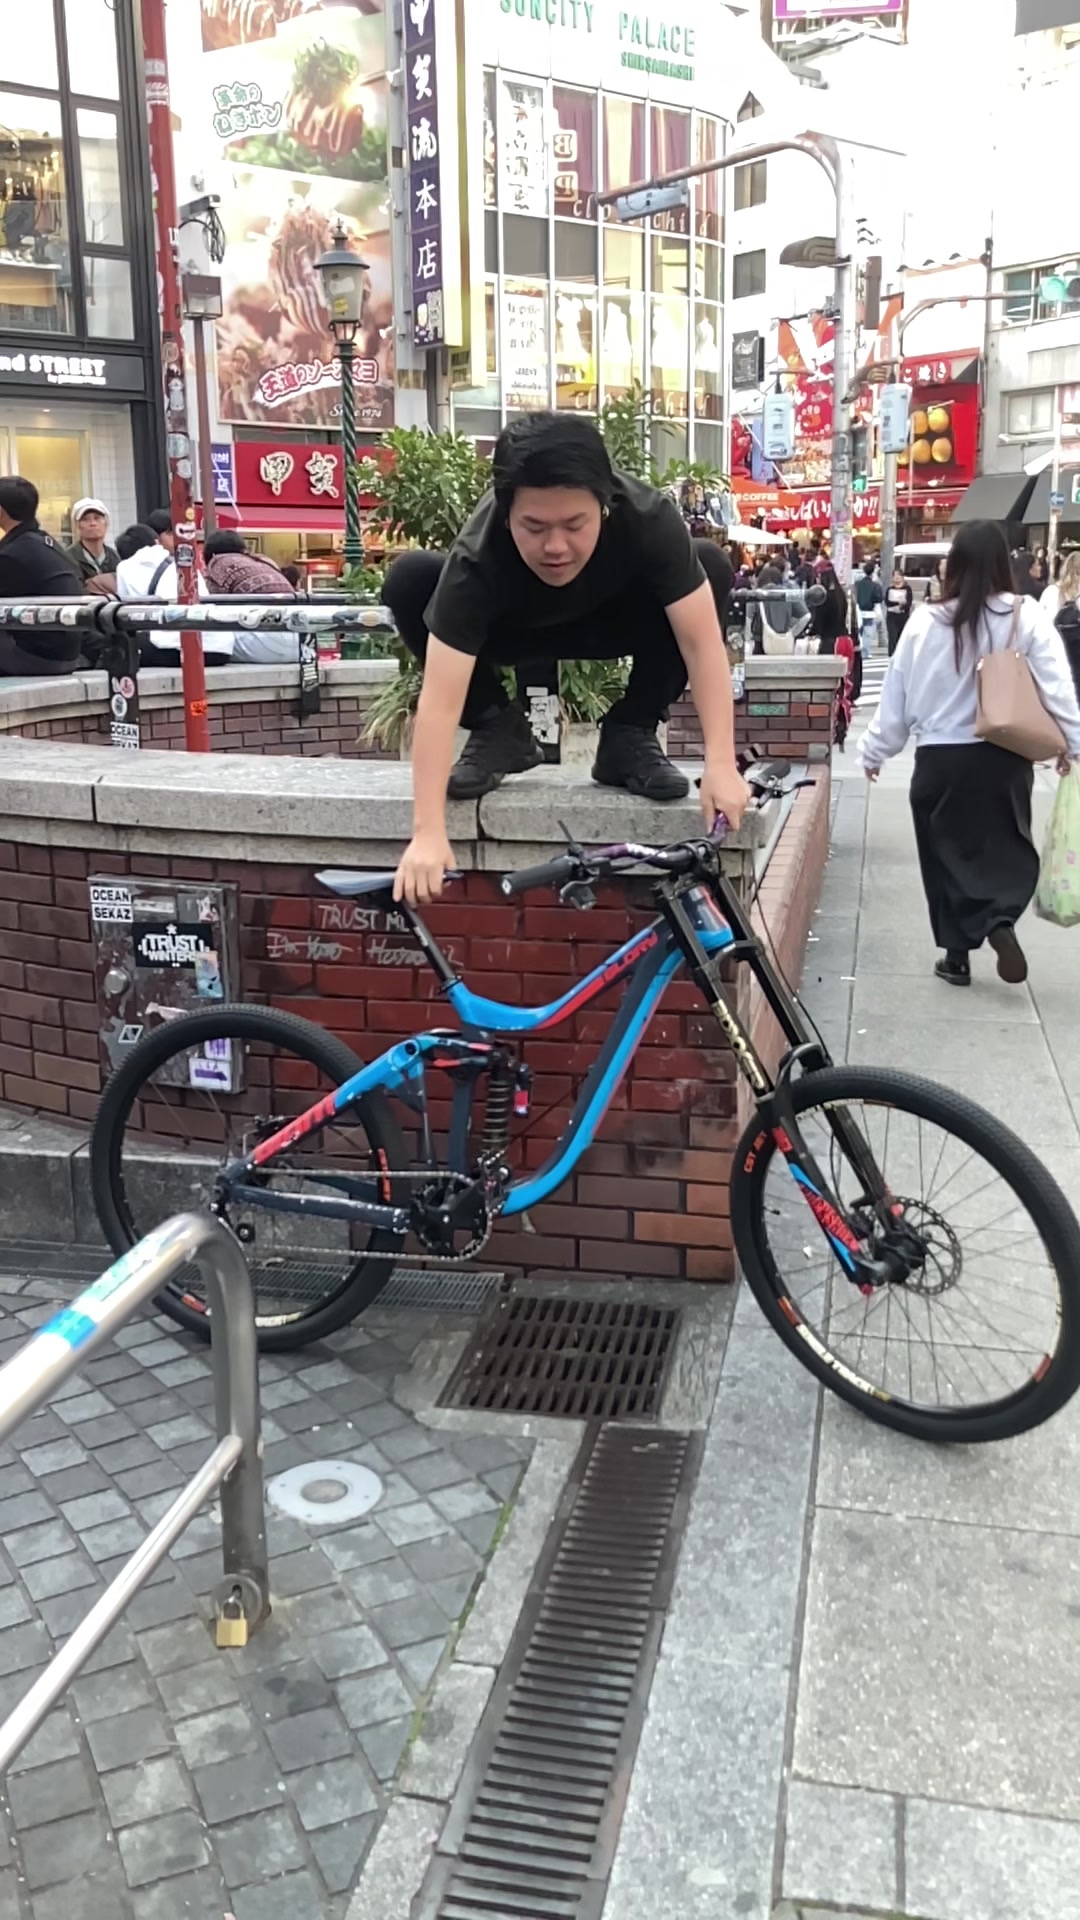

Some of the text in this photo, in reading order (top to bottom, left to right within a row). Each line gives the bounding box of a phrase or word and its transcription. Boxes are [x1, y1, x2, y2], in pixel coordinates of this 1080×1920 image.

[618, 11, 695, 57] PALACE
[29, 354, 105, 376] STREET
[92, 889, 130, 903] OCEAN
[94, 906, 132, 920] SEKAZ
[318, 904, 380, 931] TRUST
[144, 933, 199, 951] TRUST
